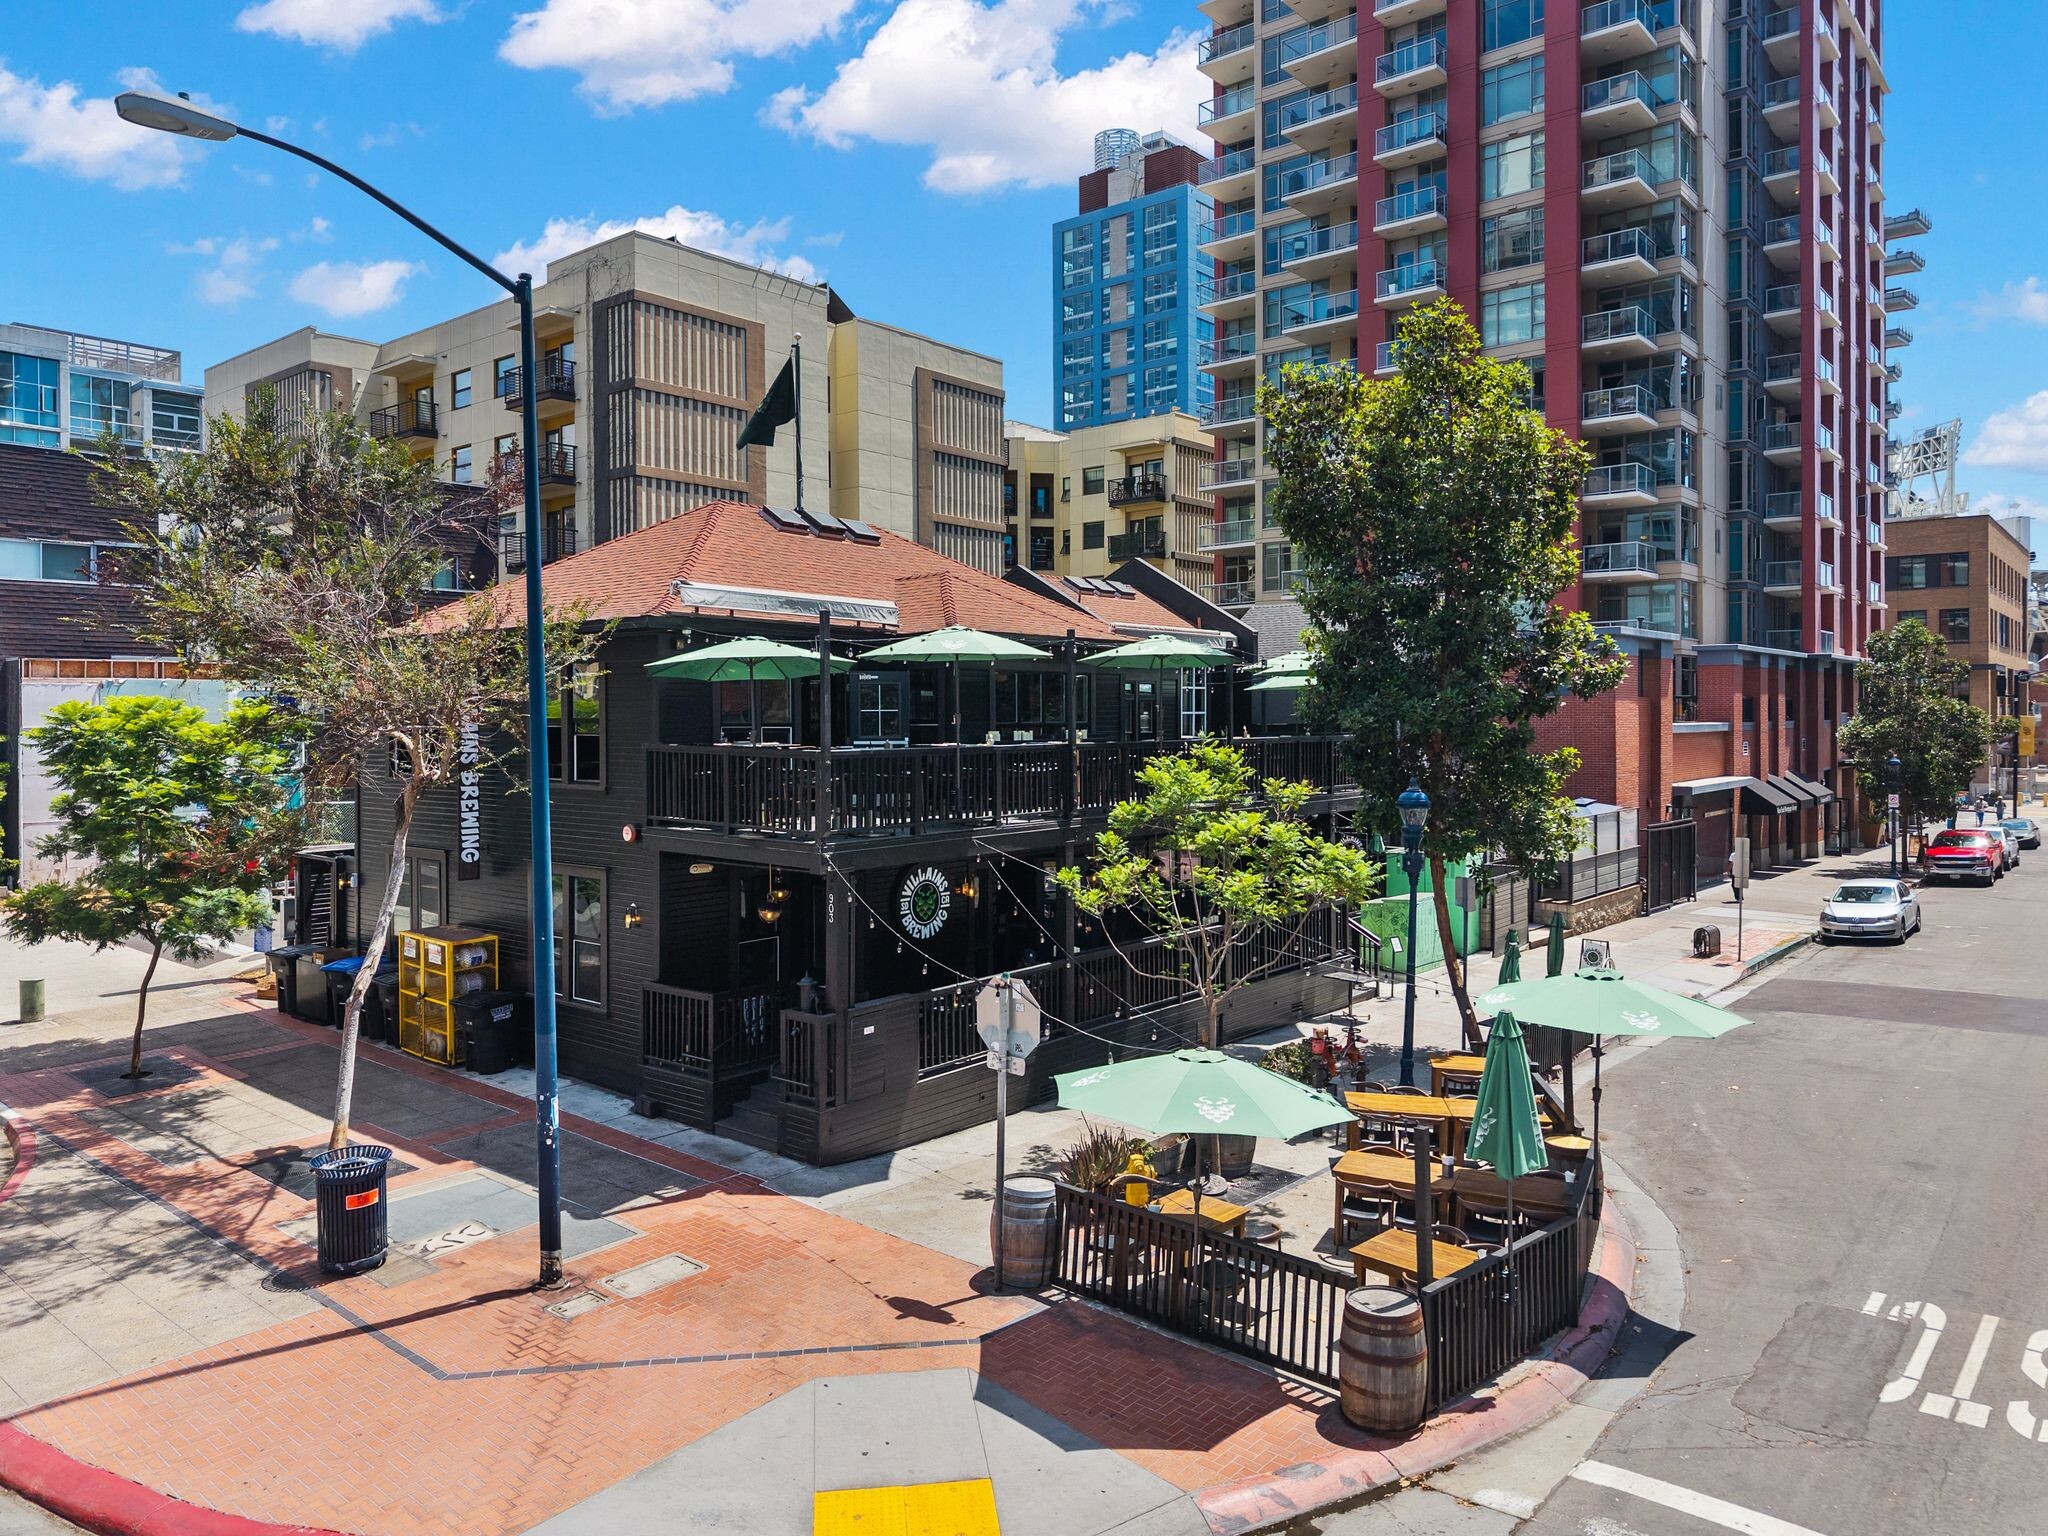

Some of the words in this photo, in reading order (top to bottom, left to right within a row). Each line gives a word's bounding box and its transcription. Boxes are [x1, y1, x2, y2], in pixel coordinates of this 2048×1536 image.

[460, 770, 480, 863] BREWING
[901, 866, 949, 896] VILLAINS
[900, 901, 909, 911] SD
[941, 895, 950, 904] CA
[901, 909, 948, 940] BREWING
